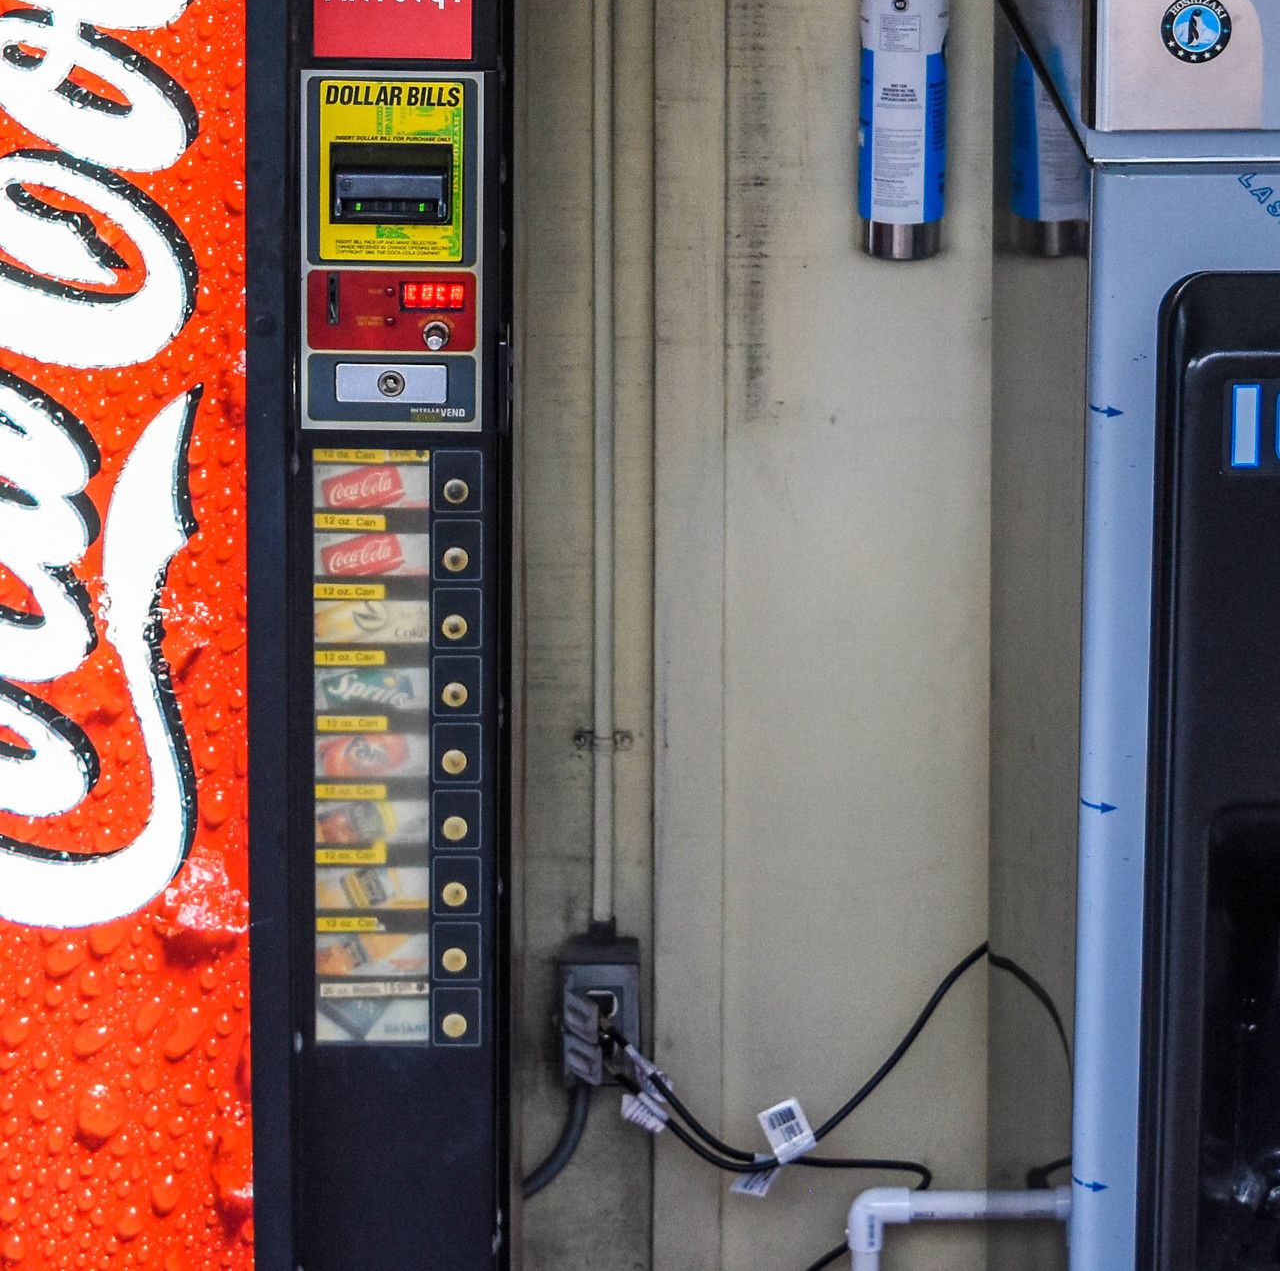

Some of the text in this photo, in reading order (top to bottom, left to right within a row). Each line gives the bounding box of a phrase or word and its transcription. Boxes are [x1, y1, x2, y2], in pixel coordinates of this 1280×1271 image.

[325, 84, 461, 108] DOLLAR BILLS
[407, 284, 464, 301] COCA
[329, 471, 392, 506] Coca-Cola
[324, 515, 335, 525] 12
[356, 517, 376, 527] Can
[329, 538, 391, 573] Coca-Cola
[324, 587, 335, 596] 12
[355, 587, 375, 596] Can
[324, 653, 335, 662] 12
